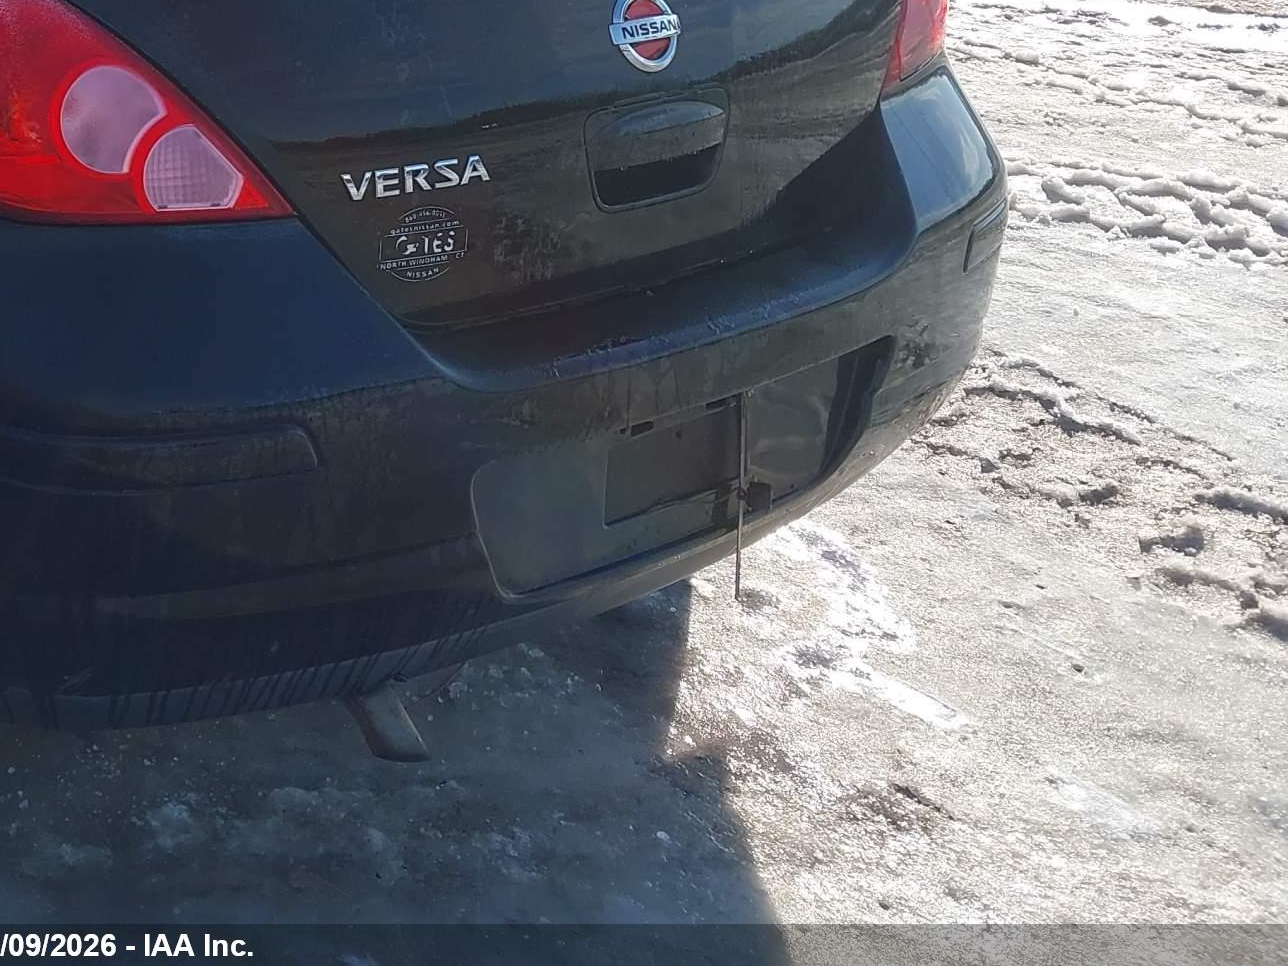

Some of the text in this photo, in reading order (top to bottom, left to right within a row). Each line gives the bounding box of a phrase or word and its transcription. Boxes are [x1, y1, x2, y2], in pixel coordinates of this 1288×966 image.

[621, 17, 678, 39] NISSAN
[341, 154, 491, 201] VERSA
[395, 230, 456, 255] GTES
[380, 259, 407, 271] NORTH
[409, 254, 448, 266] WINDHAM
[406, 267, 439, 279] NISSAN
